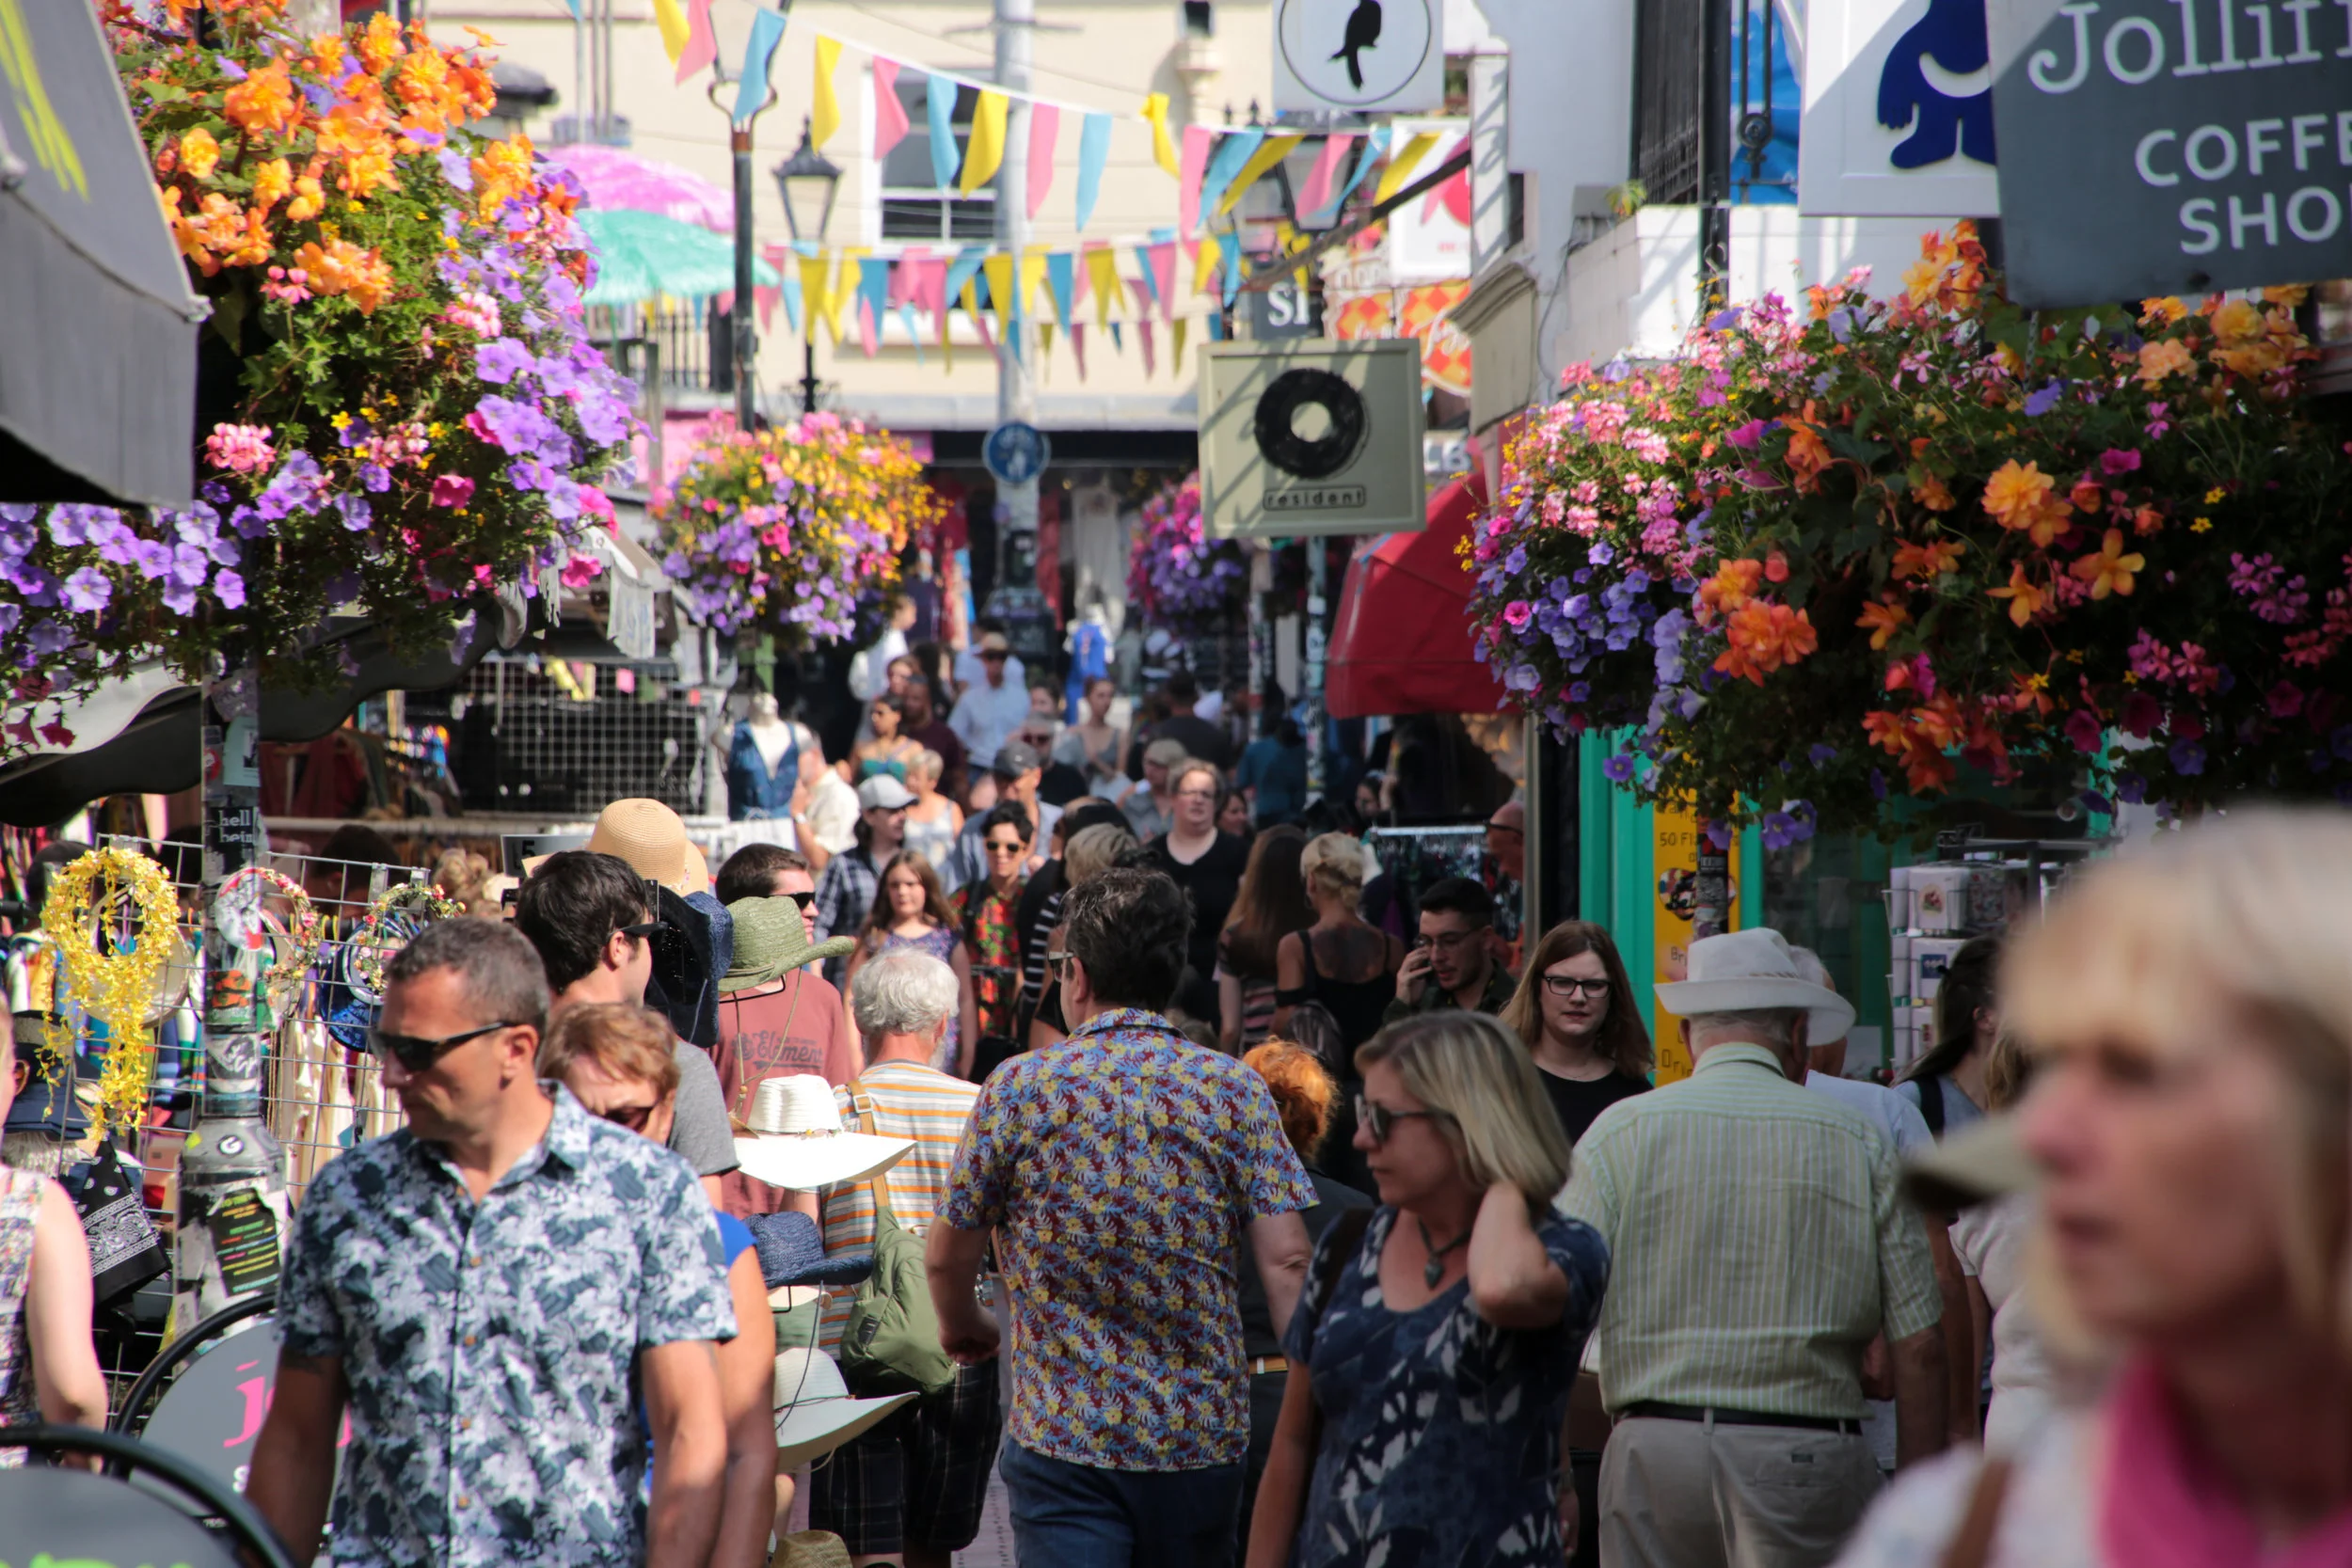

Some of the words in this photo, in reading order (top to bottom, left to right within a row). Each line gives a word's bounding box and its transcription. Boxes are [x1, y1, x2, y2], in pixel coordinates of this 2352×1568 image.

[2027, 0, 2352, 93] Jollif
[2179, 182, 2352, 255] SHO
[1267, 491, 1361, 506] resident
